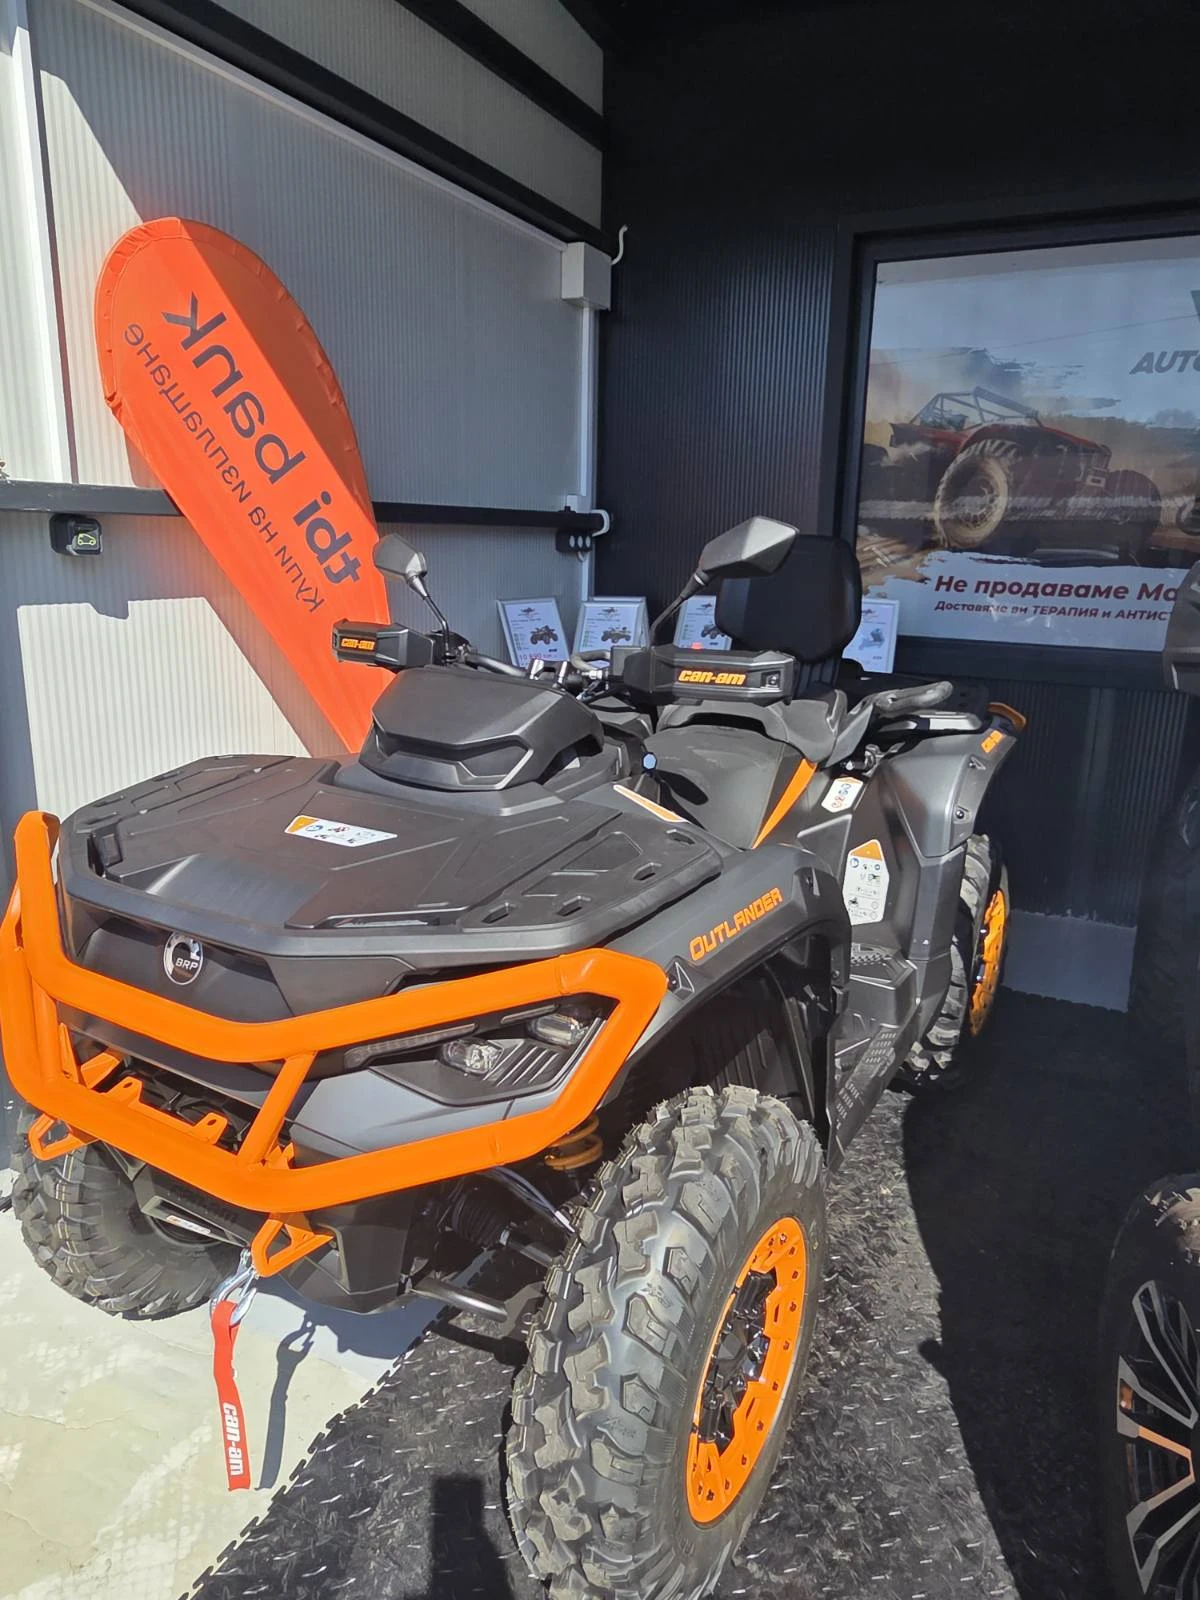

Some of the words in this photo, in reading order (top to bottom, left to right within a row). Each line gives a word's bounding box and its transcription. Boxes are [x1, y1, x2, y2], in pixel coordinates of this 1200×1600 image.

[934, 575, 968, 592] Не
[974, 580, 1129, 600] продаваме
[1032, 605, 1099, 618] ТЕРАПИЯ
[1114, 609, 1173, 621] АНТИС
[678, 669, 746, 685] can-am
[689, 887, 783, 961] OUTLANDER
[175, 957, 199, 971] BRP
[223, 1402, 244, 1476] can-am
